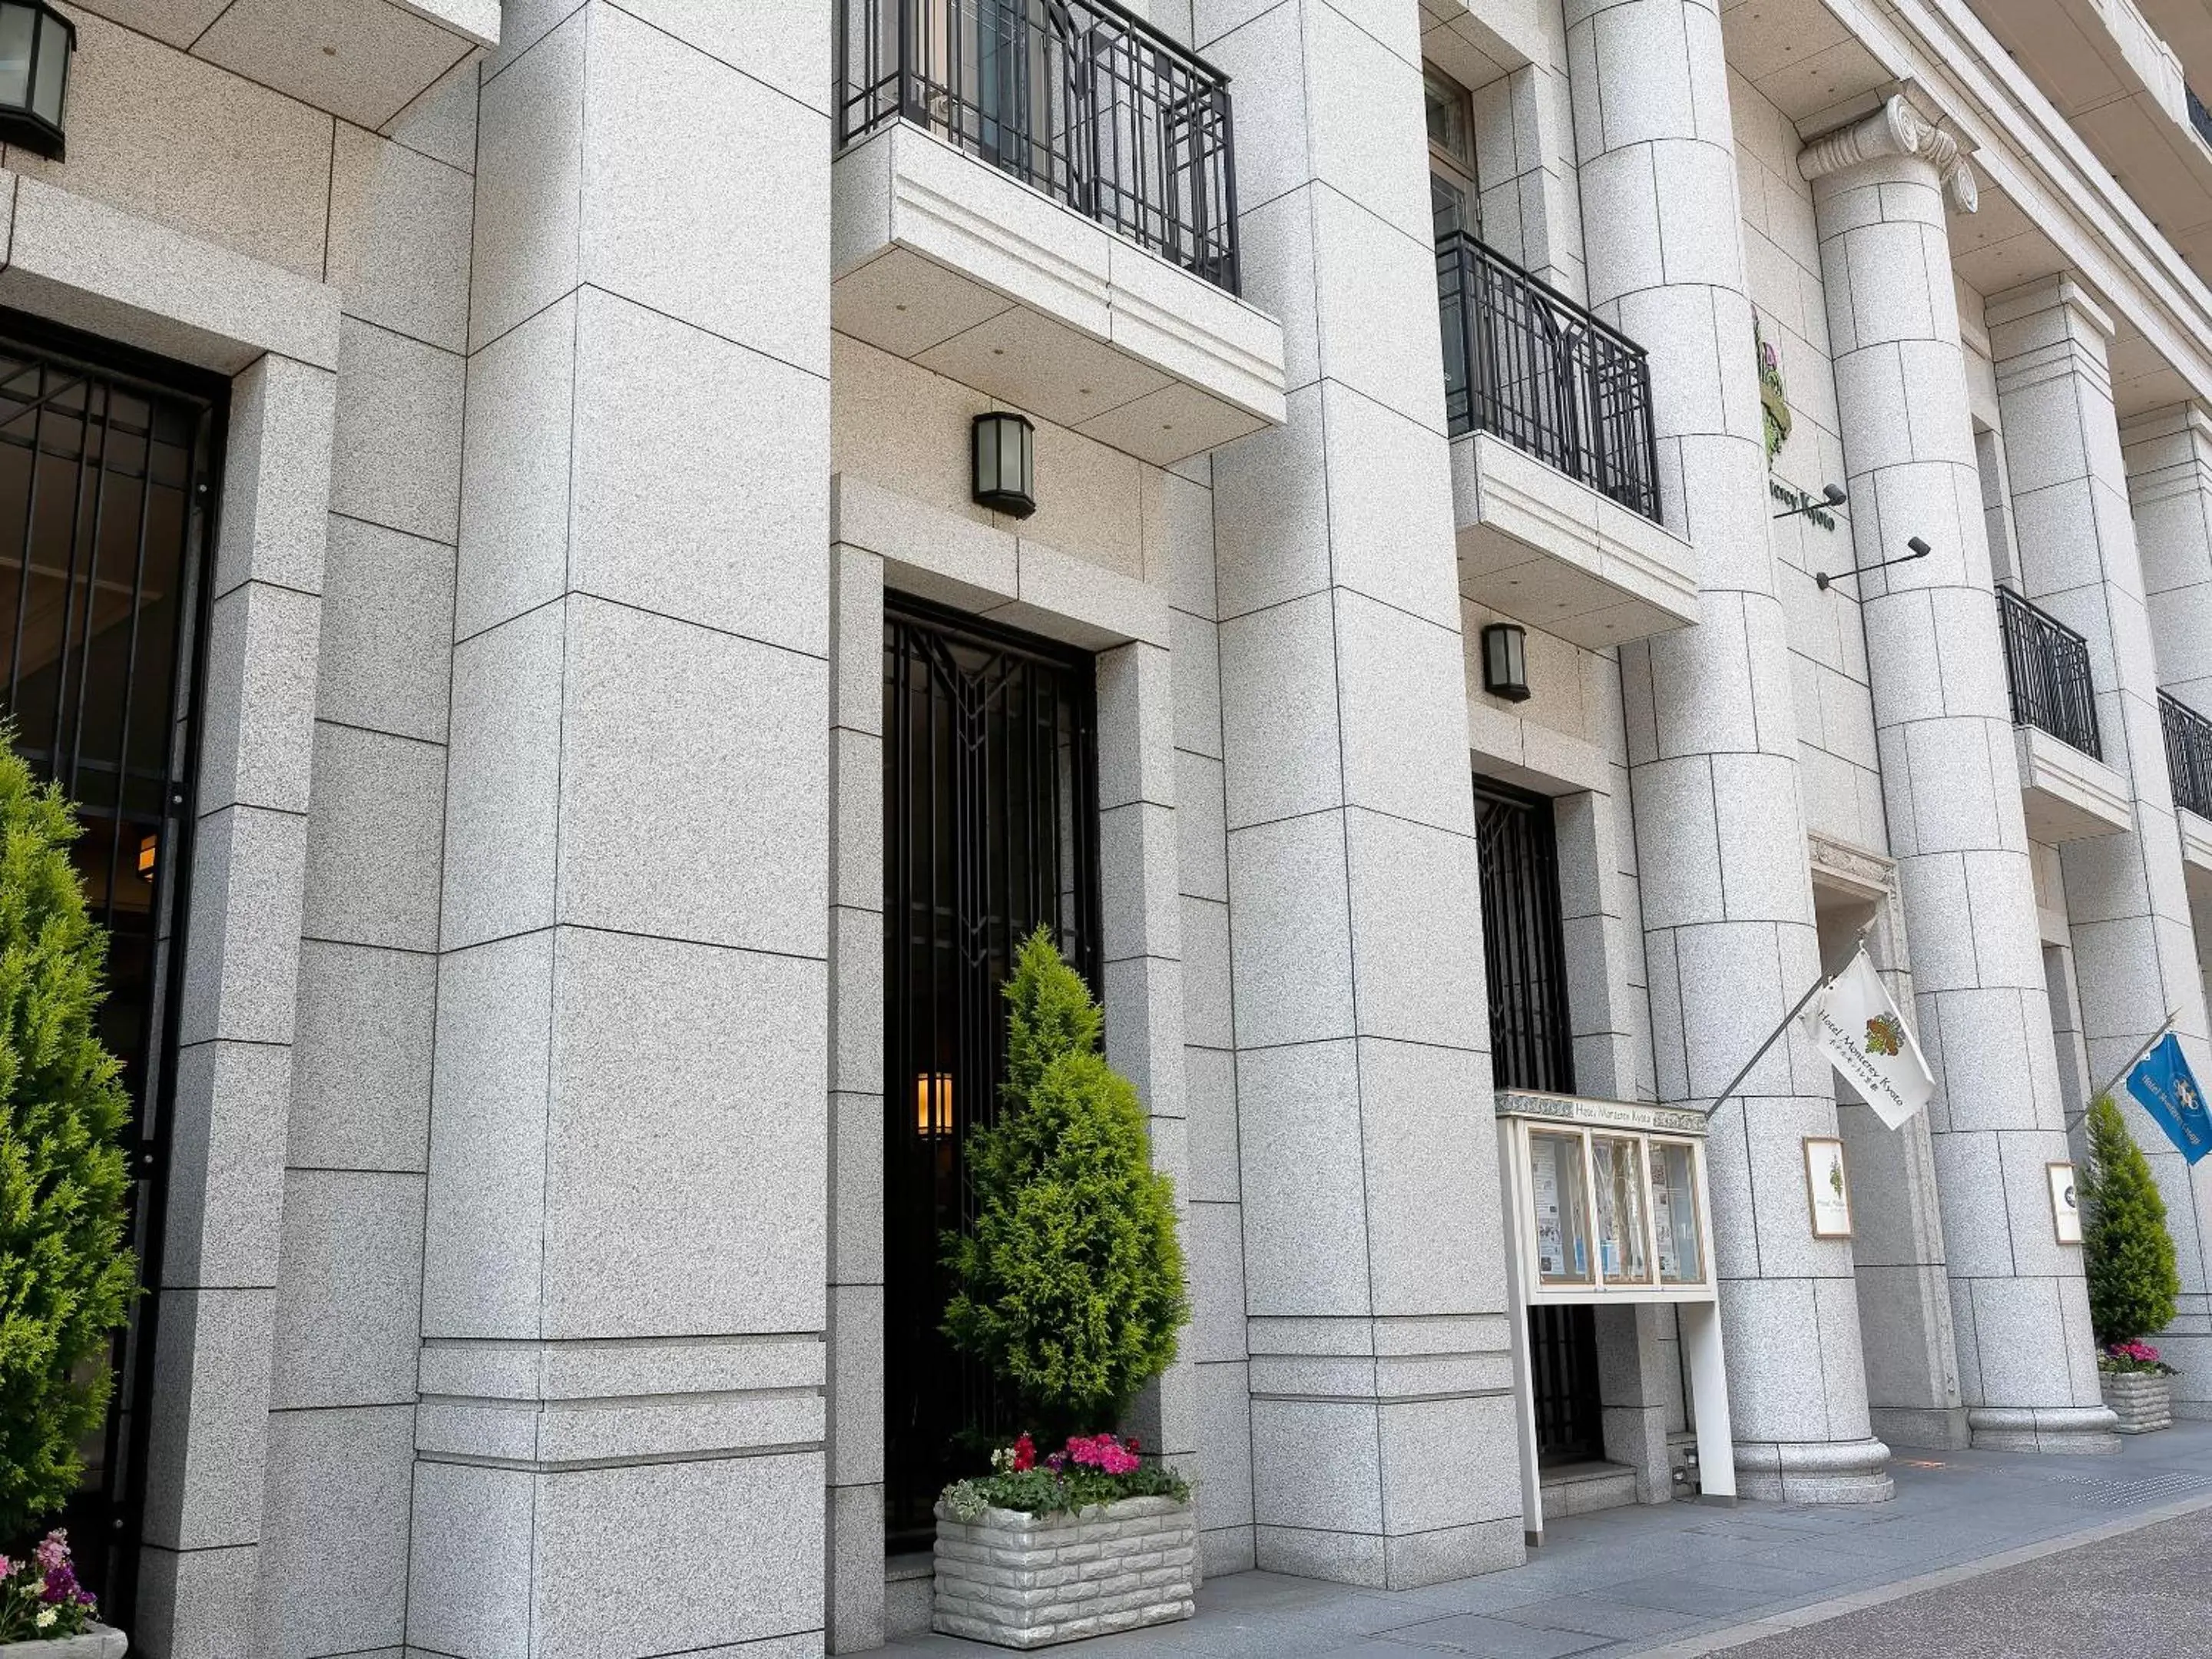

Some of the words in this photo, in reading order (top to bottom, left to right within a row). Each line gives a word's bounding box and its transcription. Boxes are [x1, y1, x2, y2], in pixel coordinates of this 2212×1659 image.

[1800, 492, 1835, 531] Kyoto
[1817, 1008, 1843, 1036] Hotel
[1844, 1035, 1880, 1078] Monterey
[1879, 1077, 1903, 1107] Kyoto
